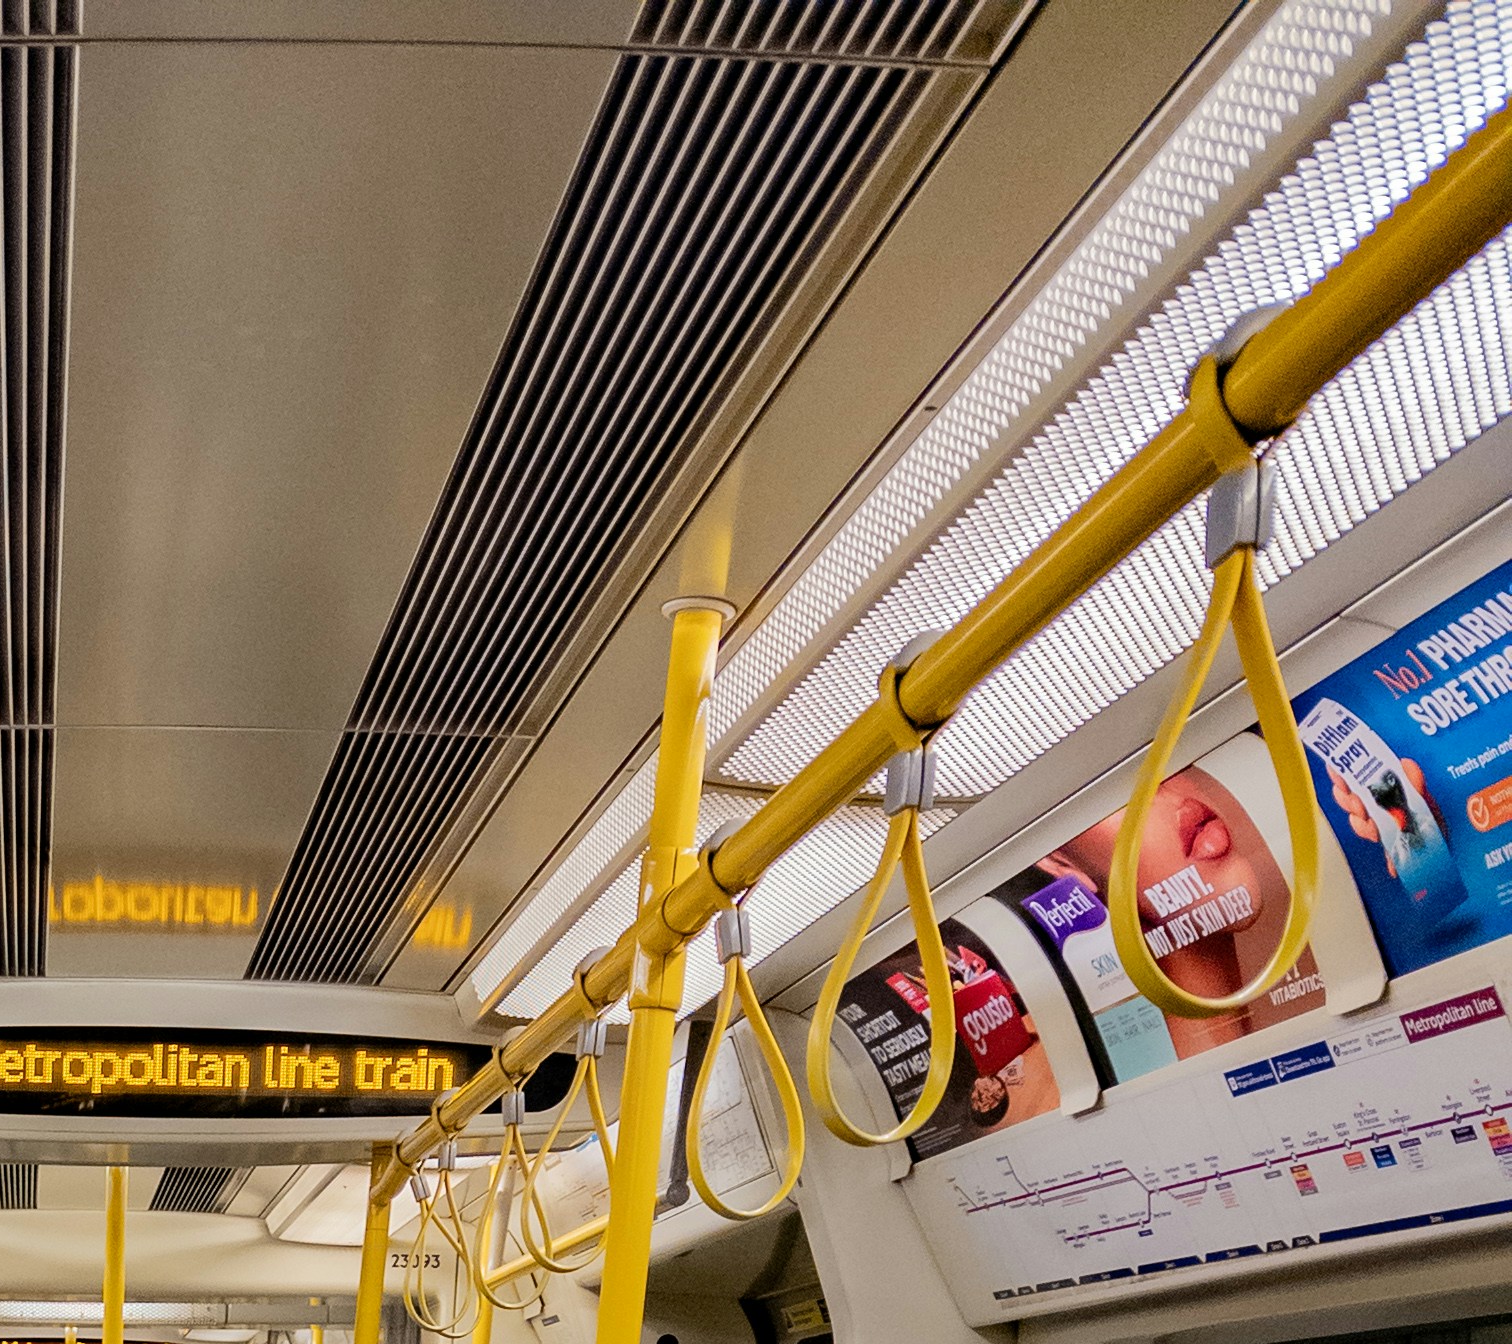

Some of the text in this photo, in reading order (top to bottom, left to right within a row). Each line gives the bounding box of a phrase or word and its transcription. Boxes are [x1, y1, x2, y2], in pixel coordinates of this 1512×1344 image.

[1373, 649, 1433, 700] No.1
[1407, 678, 1478, 736] SORE
[1313, 716, 1359, 757] Difflam
[1331, 738, 1369, 774] Spray
[1447, 757, 1479, 779] Treats
[1477, 746, 1499, 768] pain
[1144, 864, 1214, 918] BEAUTY.
[1029, 886, 1096, 939] Perfectil
[1145, 884, 1254, 960] NOT JUST SKIN DEEP
[1091, 952, 1119, 978] SKIN
[856, 1010, 901, 1043] SHORTCUT
[962, 994, 1014, 1056] gousto
[1405, 997, 1497, 1035] Metropolitan line
[871, 1023, 929, 1065] TO SERIOUSLY
[265, 1045, 339, 1090] line
[356, 1049, 454, 1091] train
[883, 1058, 912, 1087] TASTY
